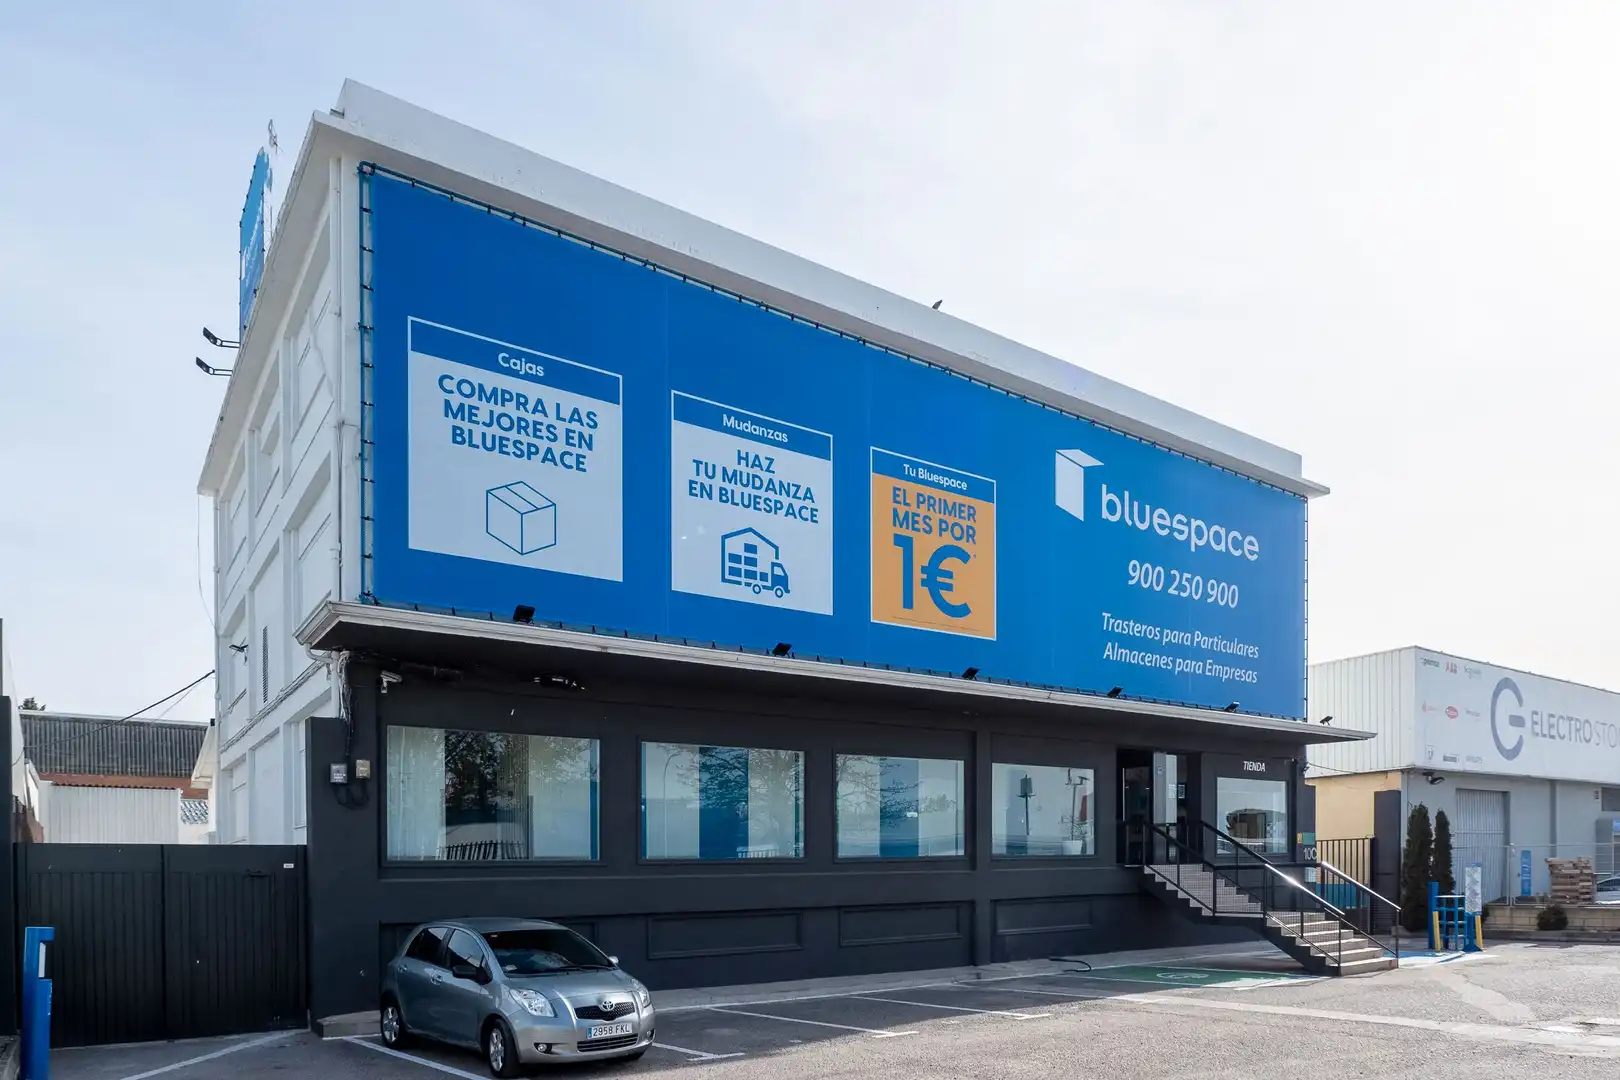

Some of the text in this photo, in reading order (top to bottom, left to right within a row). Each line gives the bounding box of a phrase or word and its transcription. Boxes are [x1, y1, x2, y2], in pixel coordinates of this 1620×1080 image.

[498, 352, 545, 377] Cajas
[437, 374, 599, 430] COMPRA LAS
[444, 398, 594, 452] MEJORES EN
[722, 413, 788, 443] Mudanzas
[451, 424, 587, 473] BLUESPACE
[736, 449, 776, 475] HAZ
[692, 458, 816, 504] TU MUDANZA
[903, 463, 968, 491] Tu Bluespace
[688, 479, 819, 524] EN BLUESPACE
[892, 486, 977, 524] EL PRIMER
[892, 507, 977, 545] MES POR
[1101, 483, 1260, 562] bluespace
[1128, 559, 1239, 609] 900 250 900
[1102, 612, 1260, 659] Trasteros para Particulares
[1103, 642, 1258, 684] Almacenes para Empresas
[1531, 710, 1620, 748] ELECTROSTO
[1243, 760, 1266, 772] TIENDA
[593, 1023, 630, 1037] 2958 FKL
